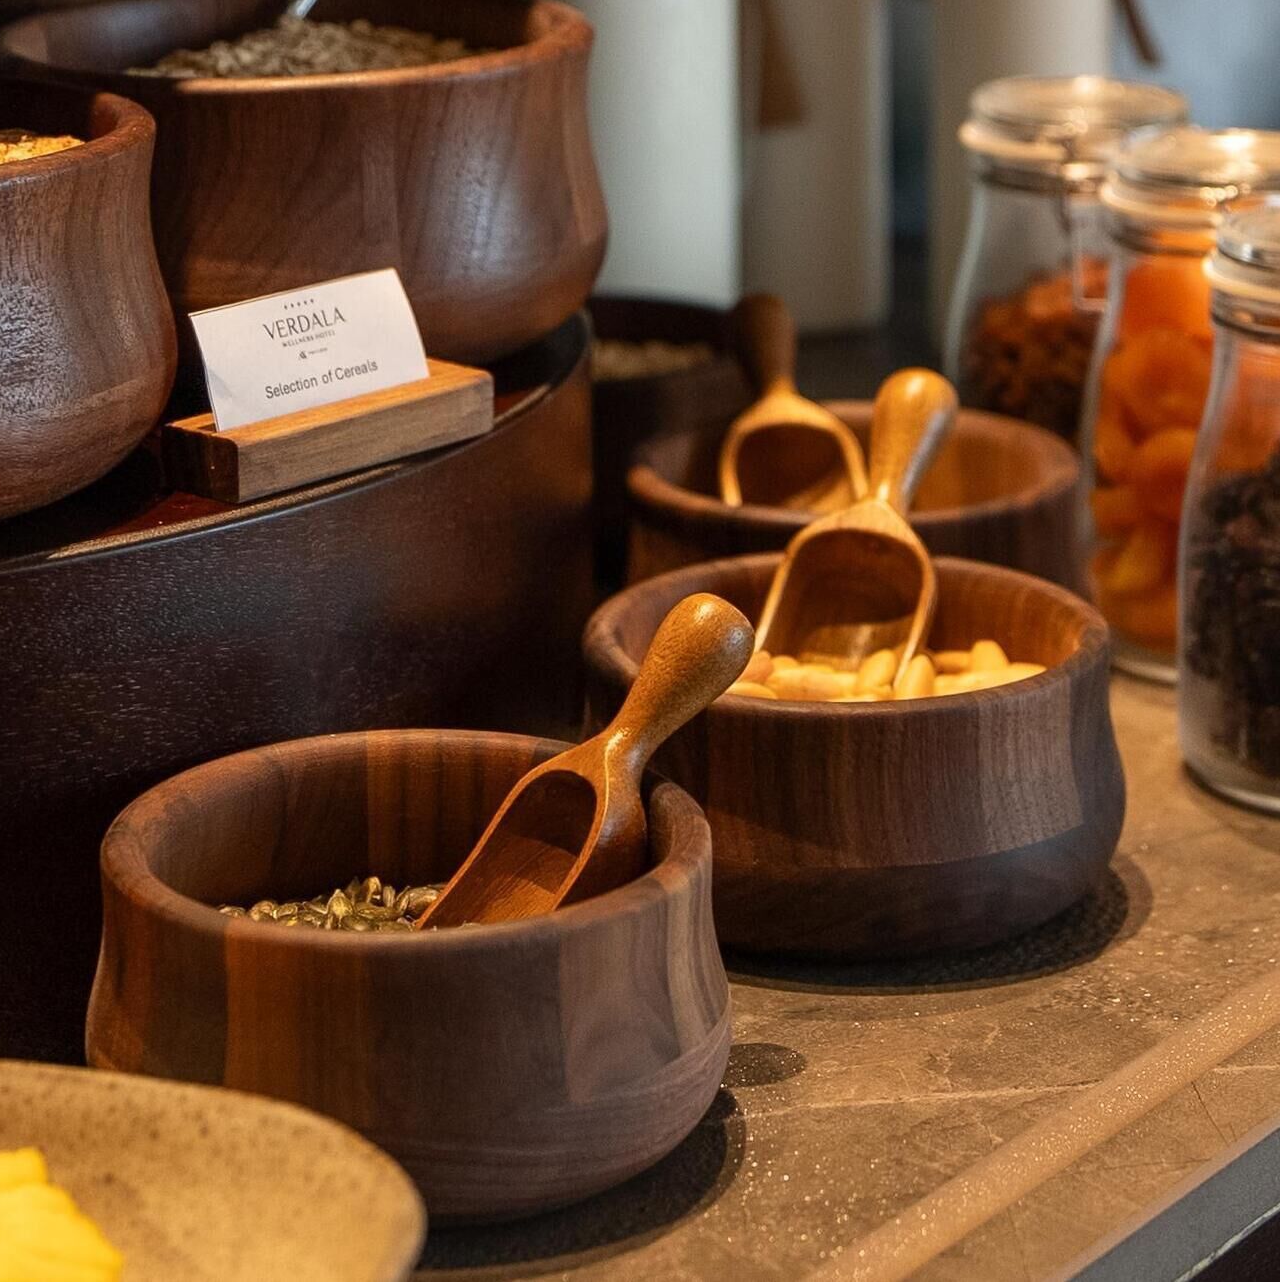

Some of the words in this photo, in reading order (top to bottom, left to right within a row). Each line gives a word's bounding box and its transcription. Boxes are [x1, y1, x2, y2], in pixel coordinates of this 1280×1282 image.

[263, 307, 346, 340] VERDALA
[265, 377, 318, 399] Selection
[322, 370, 333, 384] of
[335, 359, 378, 380] Cereals
